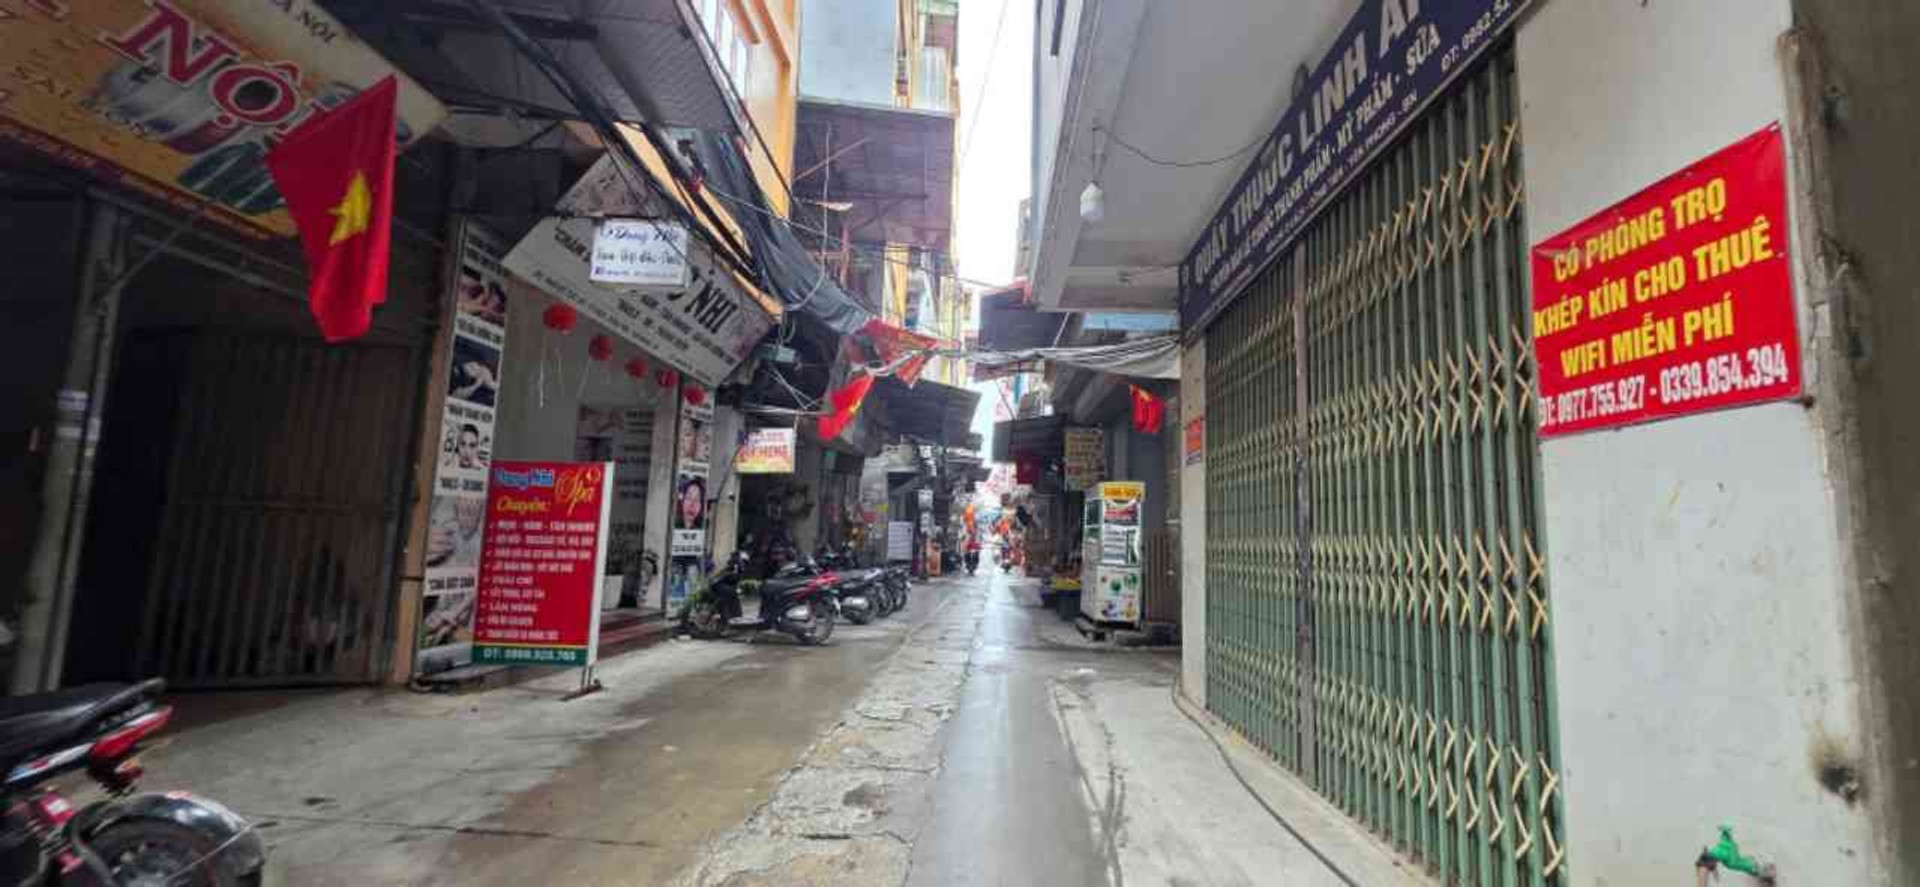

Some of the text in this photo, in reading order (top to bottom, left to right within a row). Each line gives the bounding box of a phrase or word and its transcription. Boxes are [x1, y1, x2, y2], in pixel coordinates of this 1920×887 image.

[1299, 33, 1368, 150] LINH
[1404, 22, 1442, 76] SỮA
[1553, 177, 1727, 282] CÓ PHÒNG TRỌ
[685, 276, 739, 335] NHI
[1534, 215, 1774, 338] KHÉP KÍN CHO THUÊ
[1560, 292, 1735, 378] WIFI MIỄN PHÍ
[1659, 344, 1789, 405] 0339.854.394
